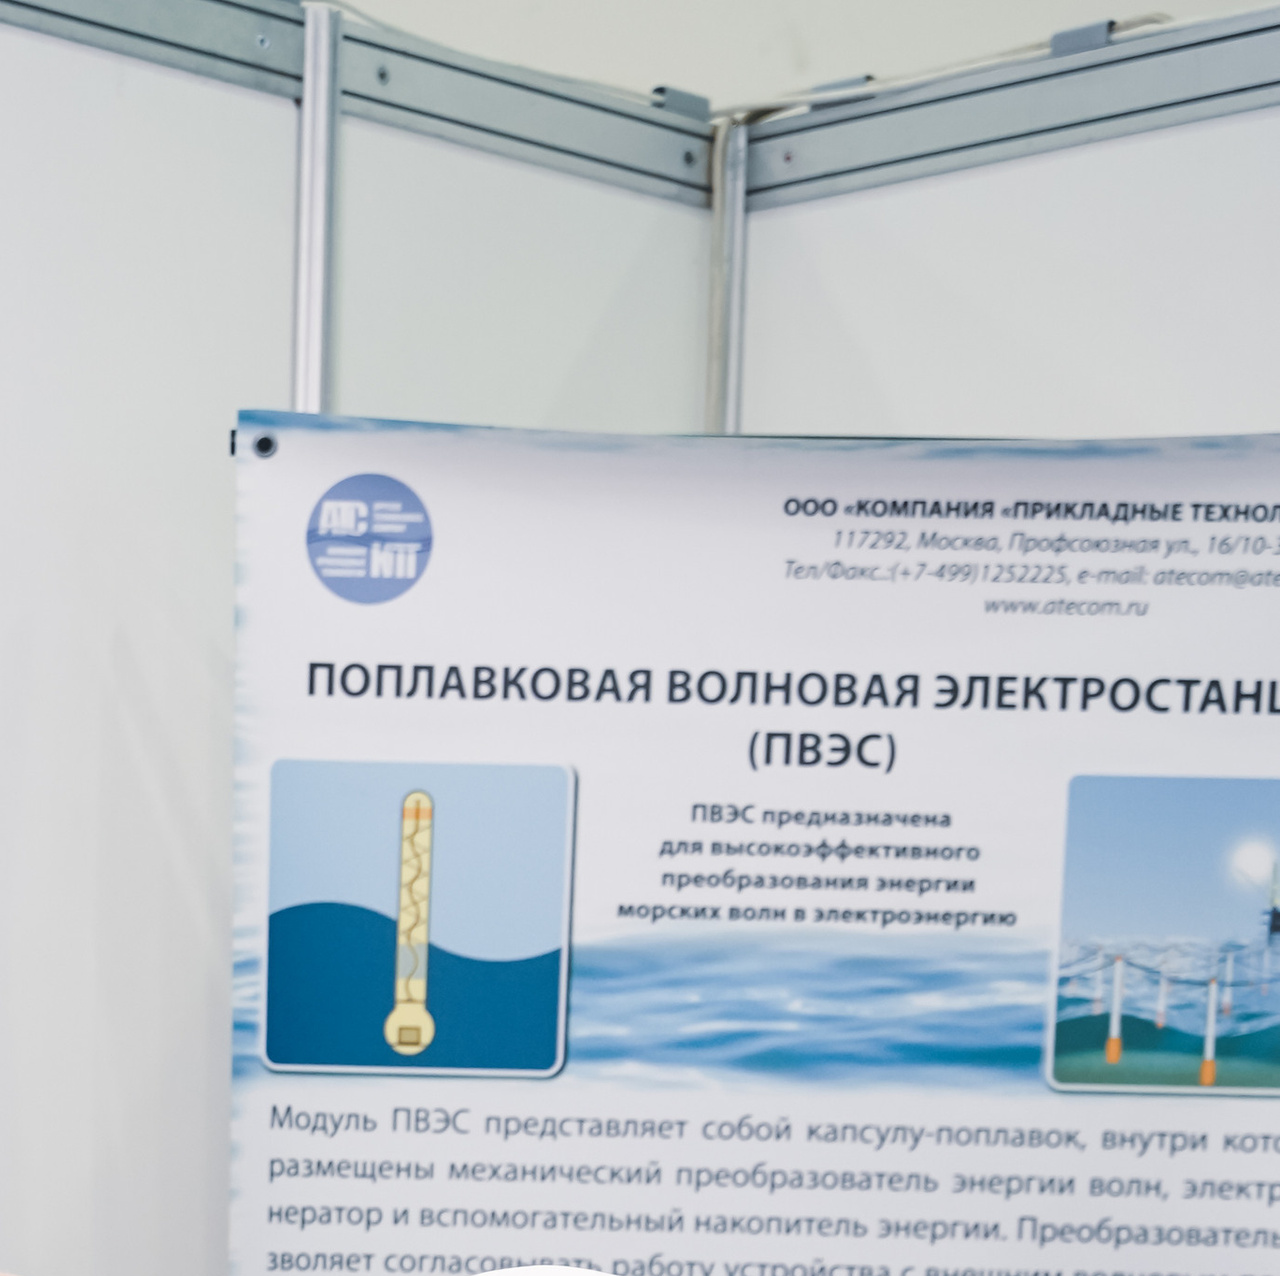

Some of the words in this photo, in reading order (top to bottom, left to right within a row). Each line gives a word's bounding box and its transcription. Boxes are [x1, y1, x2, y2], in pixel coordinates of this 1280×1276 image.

[784, 499, 838, 518] ООО
[844, 499, 995, 520] «КОМПАНИЯ
[1001, 501, 1183, 524] «ПРИКЛАДНЫЕ
[833, 530, 911, 553] 117292,
[917, 532, 1002, 555] Москва,
[1007, 531, 1160, 557] Профсоюзная
[1077, 564, 1149, 586] e-mail:
[984, 598, 1149, 617] www.atecom.ru
[306, 661, 653, 704] ПОПЛАВКОВАЯ
[666, 670, 920, 709] ВОЛНОВАЯ
[748, 731, 897, 774] (ПВЭС)
[691, 803, 756, 825] ПВЭС
[761, 808, 952, 829] предназначена
[658, 839, 704, 858] для
[711, 840, 981, 864] высокоэффективного
[661, 868, 869, 892] преобразования
[875, 876, 976, 896] энергии
[617, 903, 722, 924] морских
[729, 906, 787, 923] волн
[793, 907, 807, 923] в
[813, 908, 1018, 931] электроэнергию
[269, 1104, 378, 1137] Модуль
[390, 1107, 471, 1135] ПВЭС
[484, 1114, 688, 1141] представляет
[701, 1113, 792, 1142] собой
[806, 1121, 1087, 1152] капсулу-поплавок,
[1099, 1129, 1208, 1157] внутри
[268, 1156, 435, 1184] размещены
[447, 1158, 662, 1185] механический
[675, 1162, 939, 1193] преобразователь
[950, 1171, 1076, 1199] энергии
[1088, 1176, 1171, 1200] волн,
[267, 1205, 383, 1232] нератор
[393, 1206, 410, 1226] и
[419, 1205, 685, 1234] вспомогательный
[694, 1213, 868, 1238] накопитель
[876, 1217, 1008, 1245] энергии.
[266, 1250, 374, 1272] зволяет
